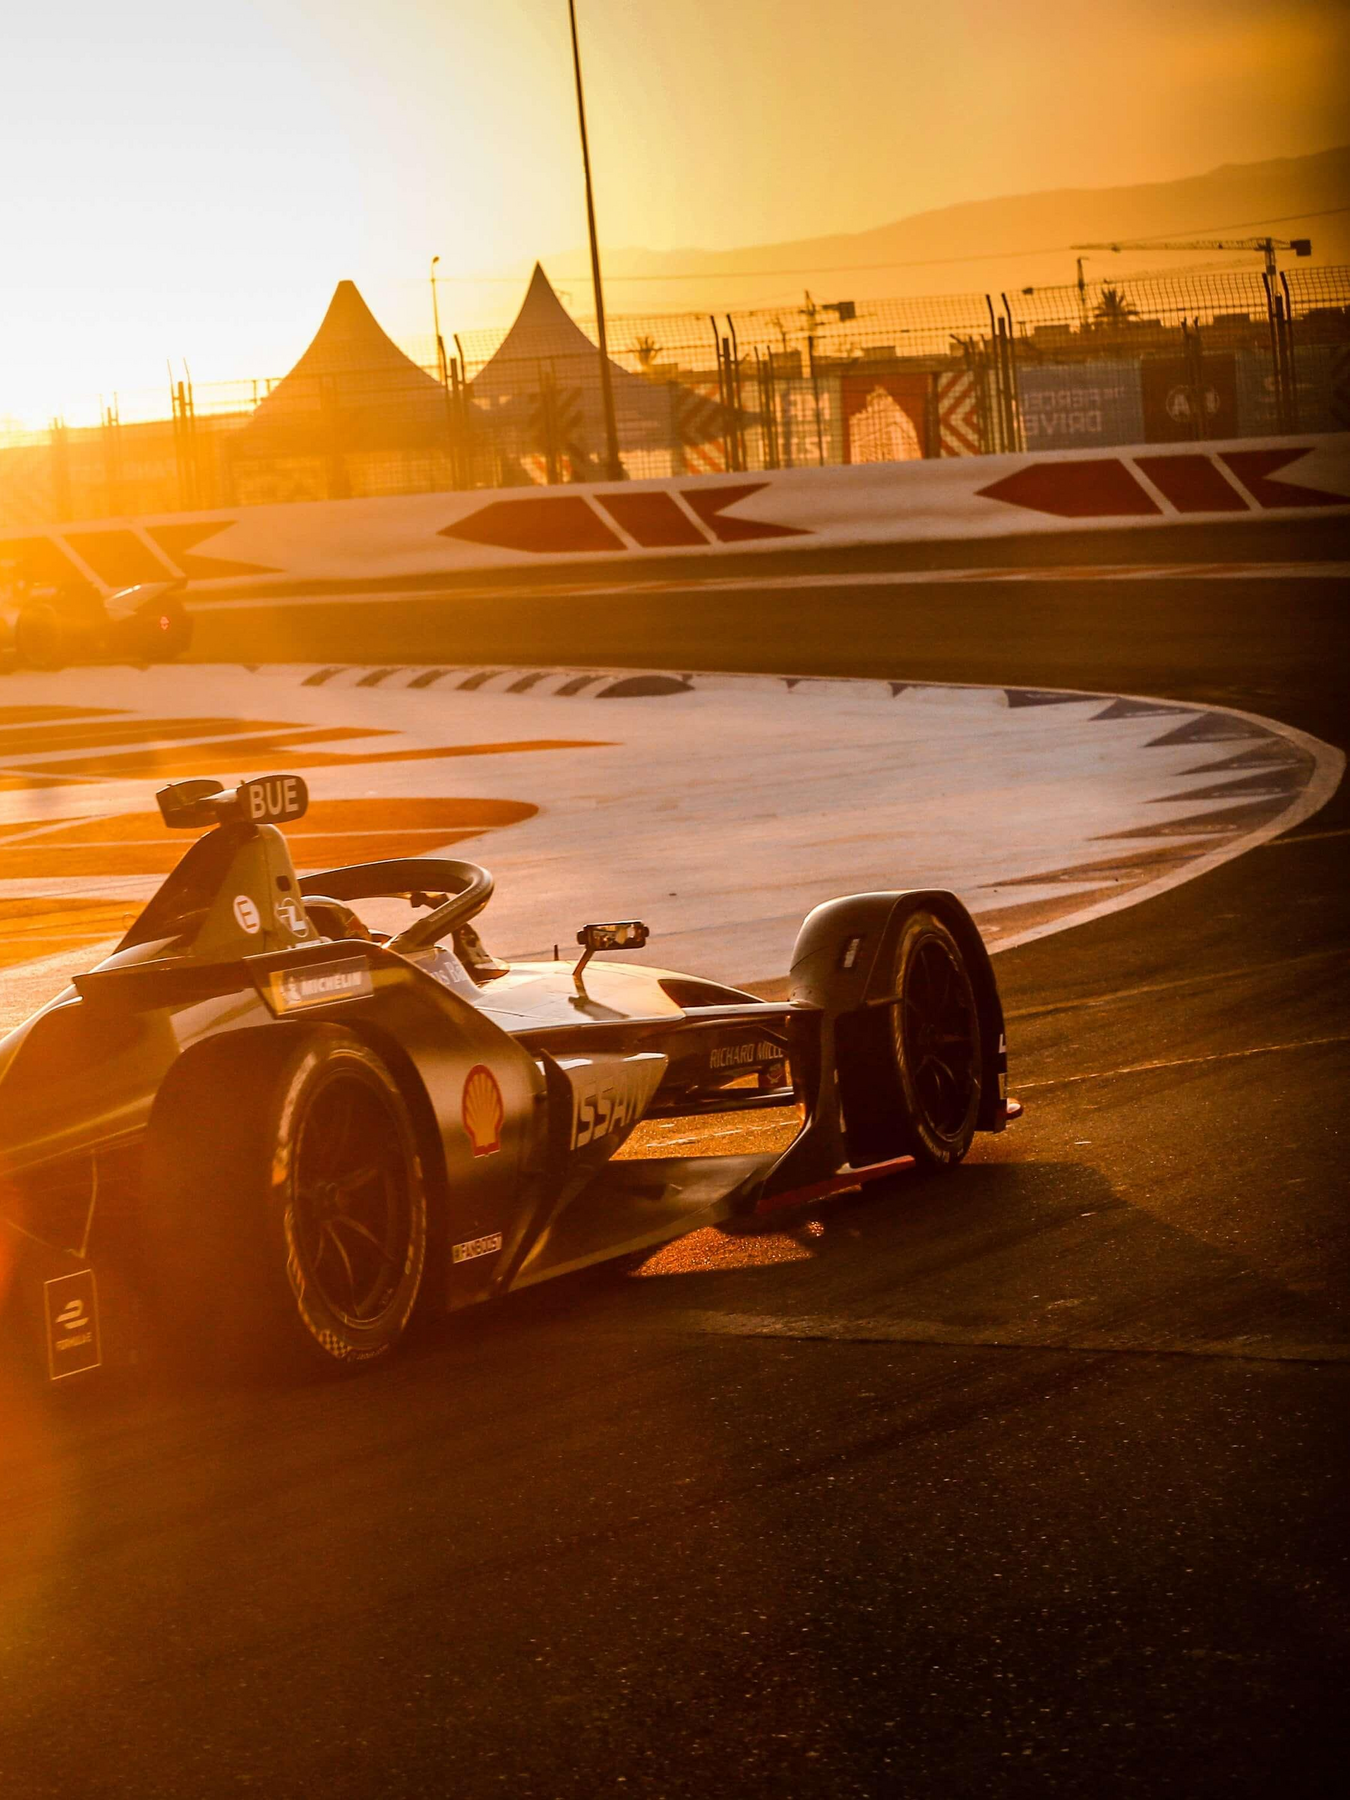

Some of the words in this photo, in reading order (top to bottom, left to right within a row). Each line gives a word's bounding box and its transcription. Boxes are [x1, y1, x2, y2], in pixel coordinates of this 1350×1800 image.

[250, 777, 299, 820] BUE
[301, 971, 363, 996] MICHELIN
[709, 1043, 755, 1069] RICHARD
[570, 1066, 650, 1151] ISSAN
